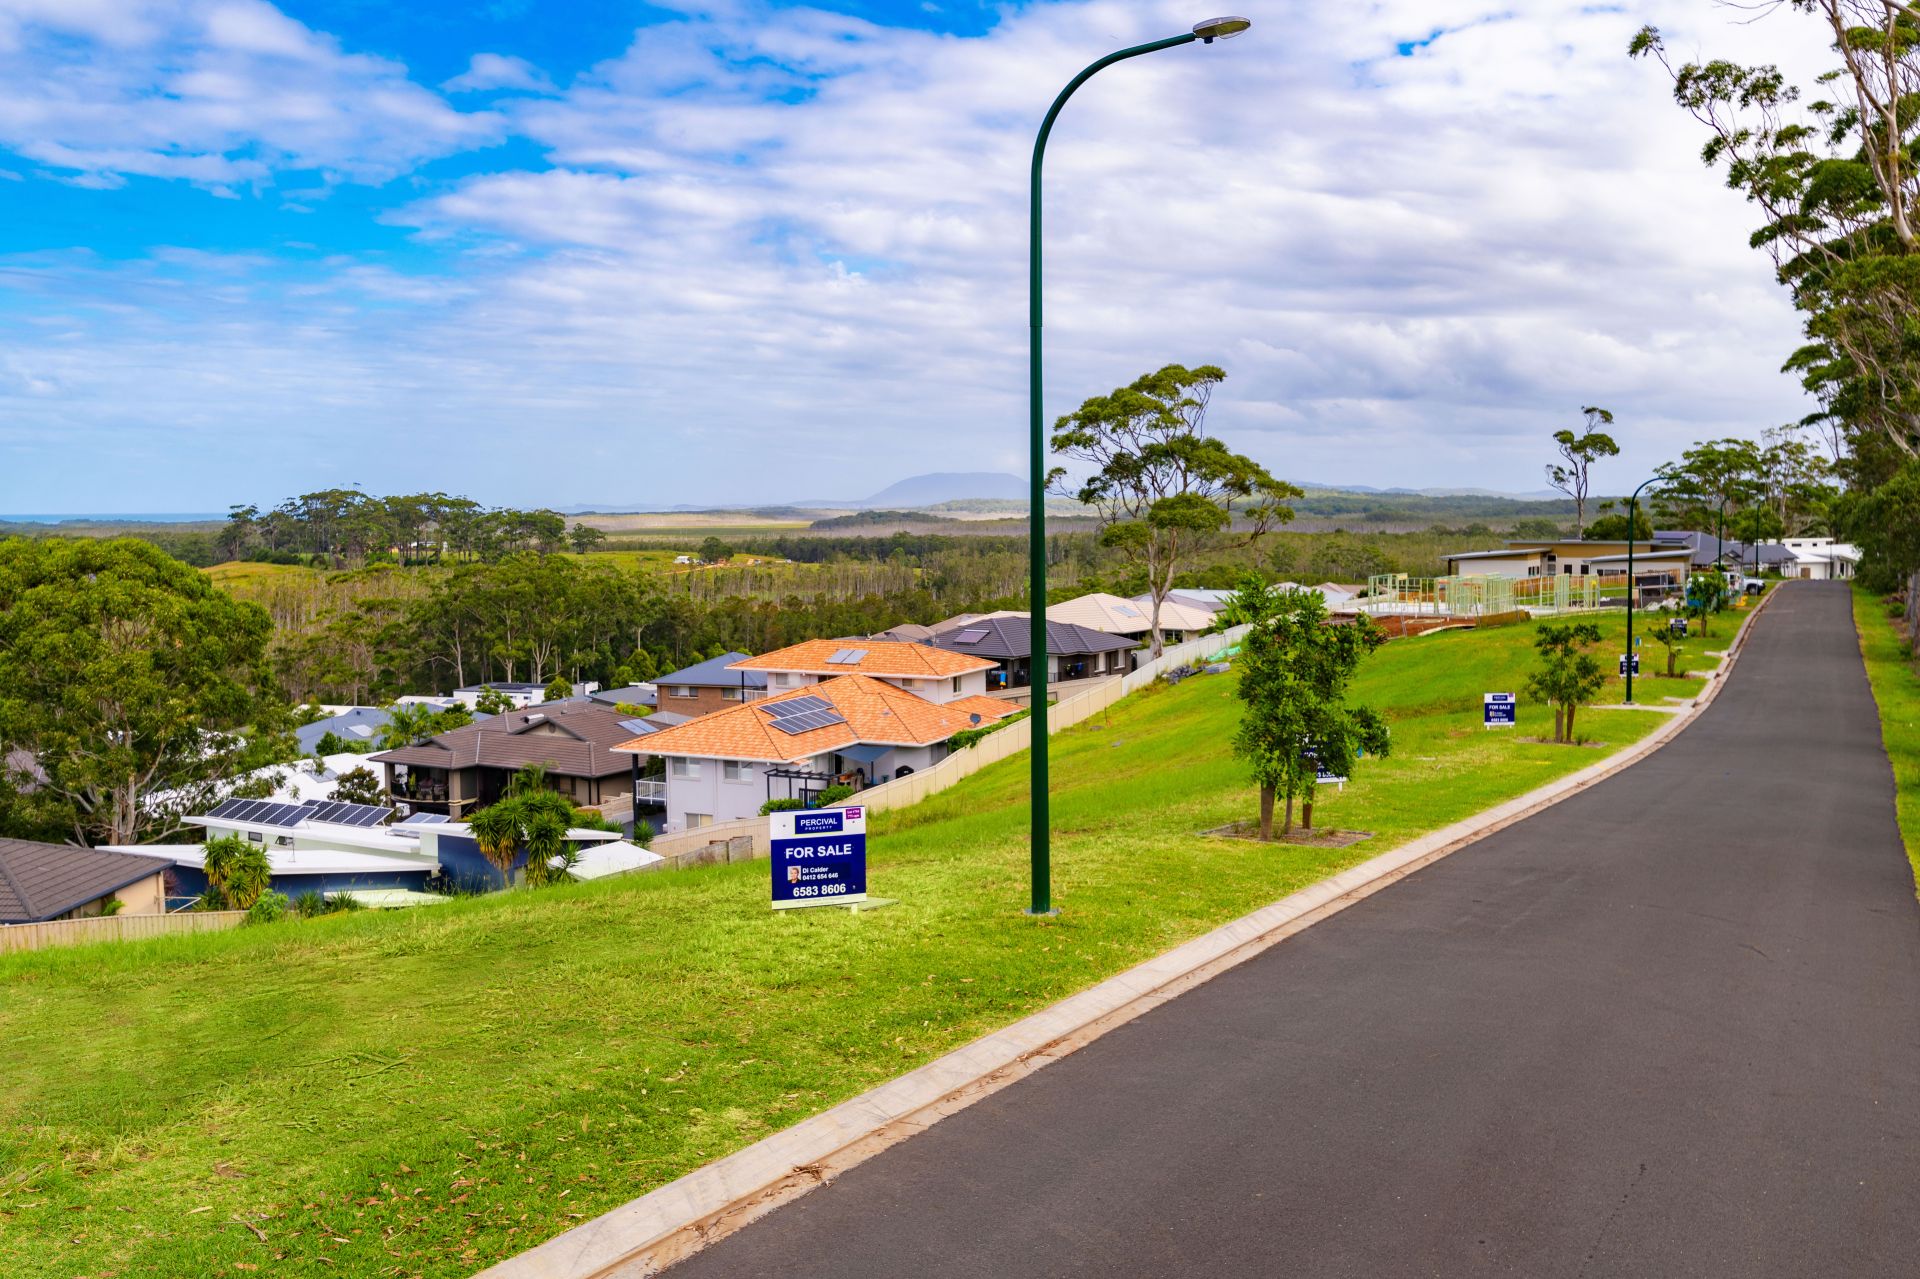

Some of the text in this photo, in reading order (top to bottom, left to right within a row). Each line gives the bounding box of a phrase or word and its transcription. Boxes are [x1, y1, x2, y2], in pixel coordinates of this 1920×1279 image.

[800, 817, 837, 826] PERCIVAL
[785, 843, 852, 859] FOR SALE
[793, 883, 846, 897] 6583 8606
